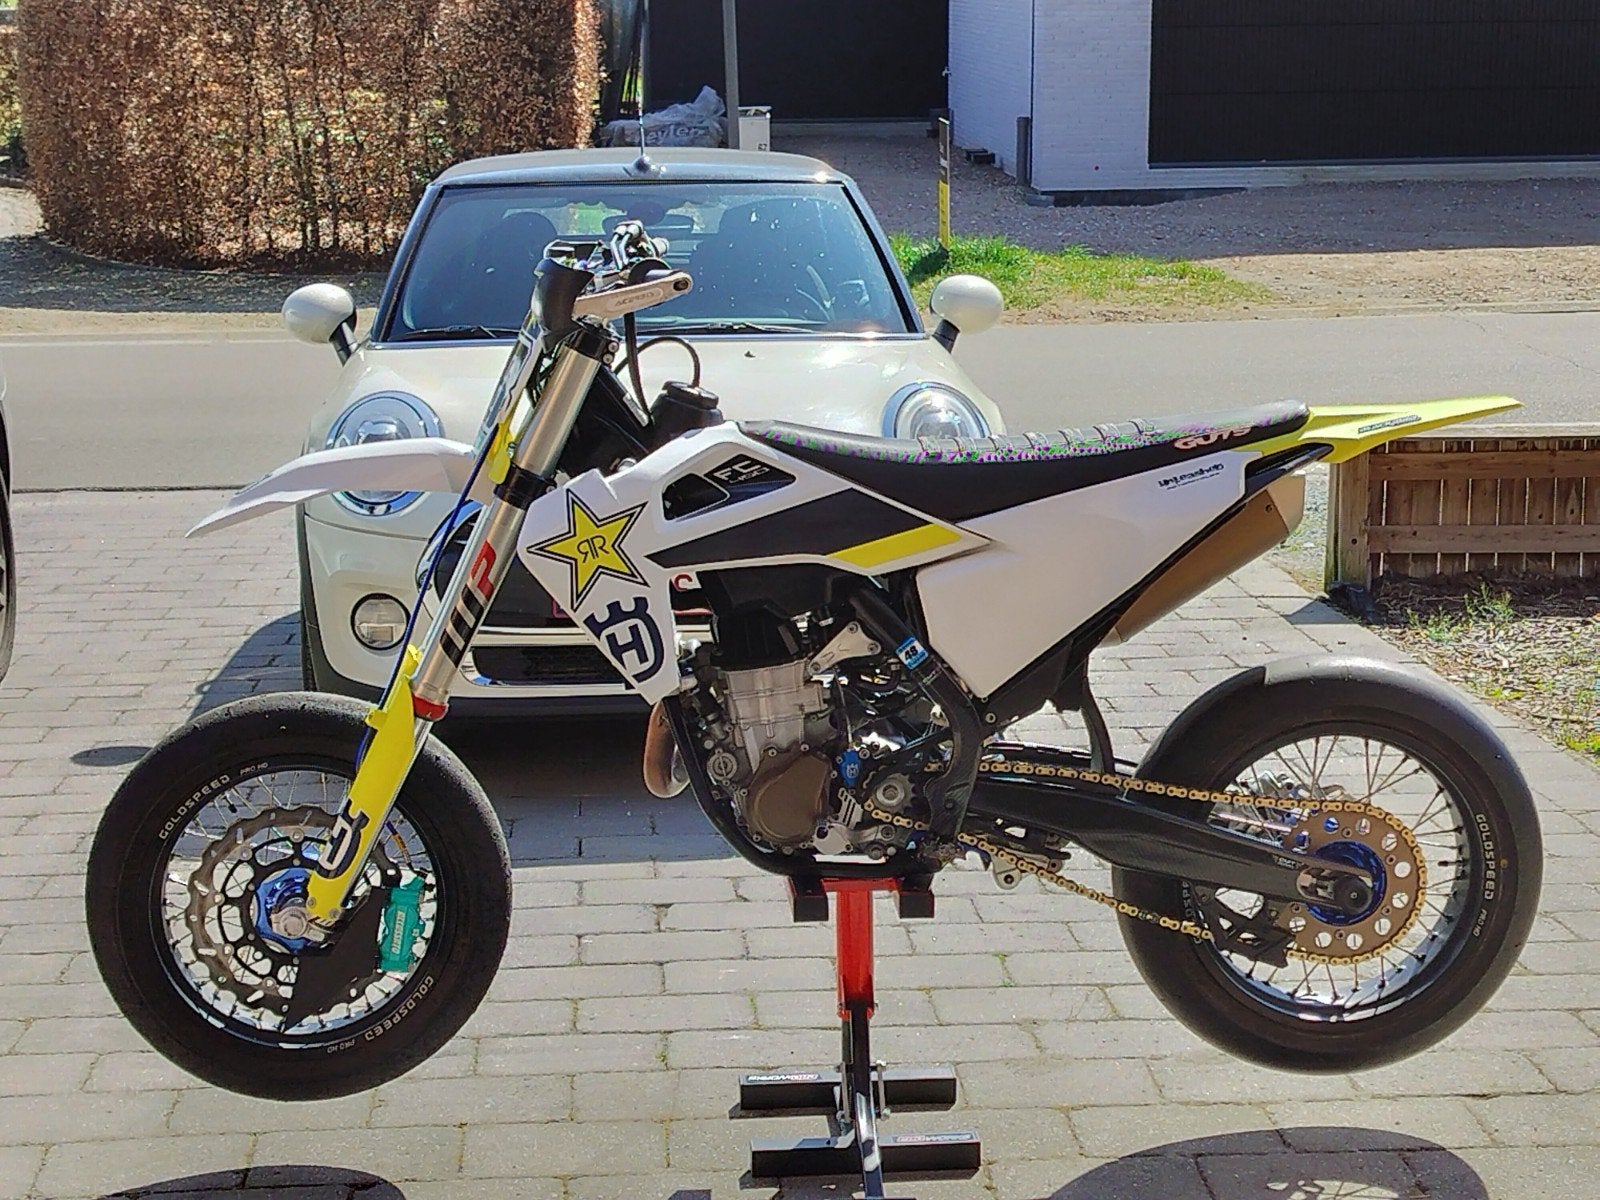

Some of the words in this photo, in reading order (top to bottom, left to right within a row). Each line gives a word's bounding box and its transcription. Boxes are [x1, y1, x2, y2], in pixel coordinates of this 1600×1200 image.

[1174, 424, 1252, 450] GUTS
[713, 460, 761, 481] FC
[158, 774, 230, 840] GOLDSPEED
[1475, 813, 1496, 900] GOLDSPEED
[365, 975, 435, 1041] GOLDSPEED
